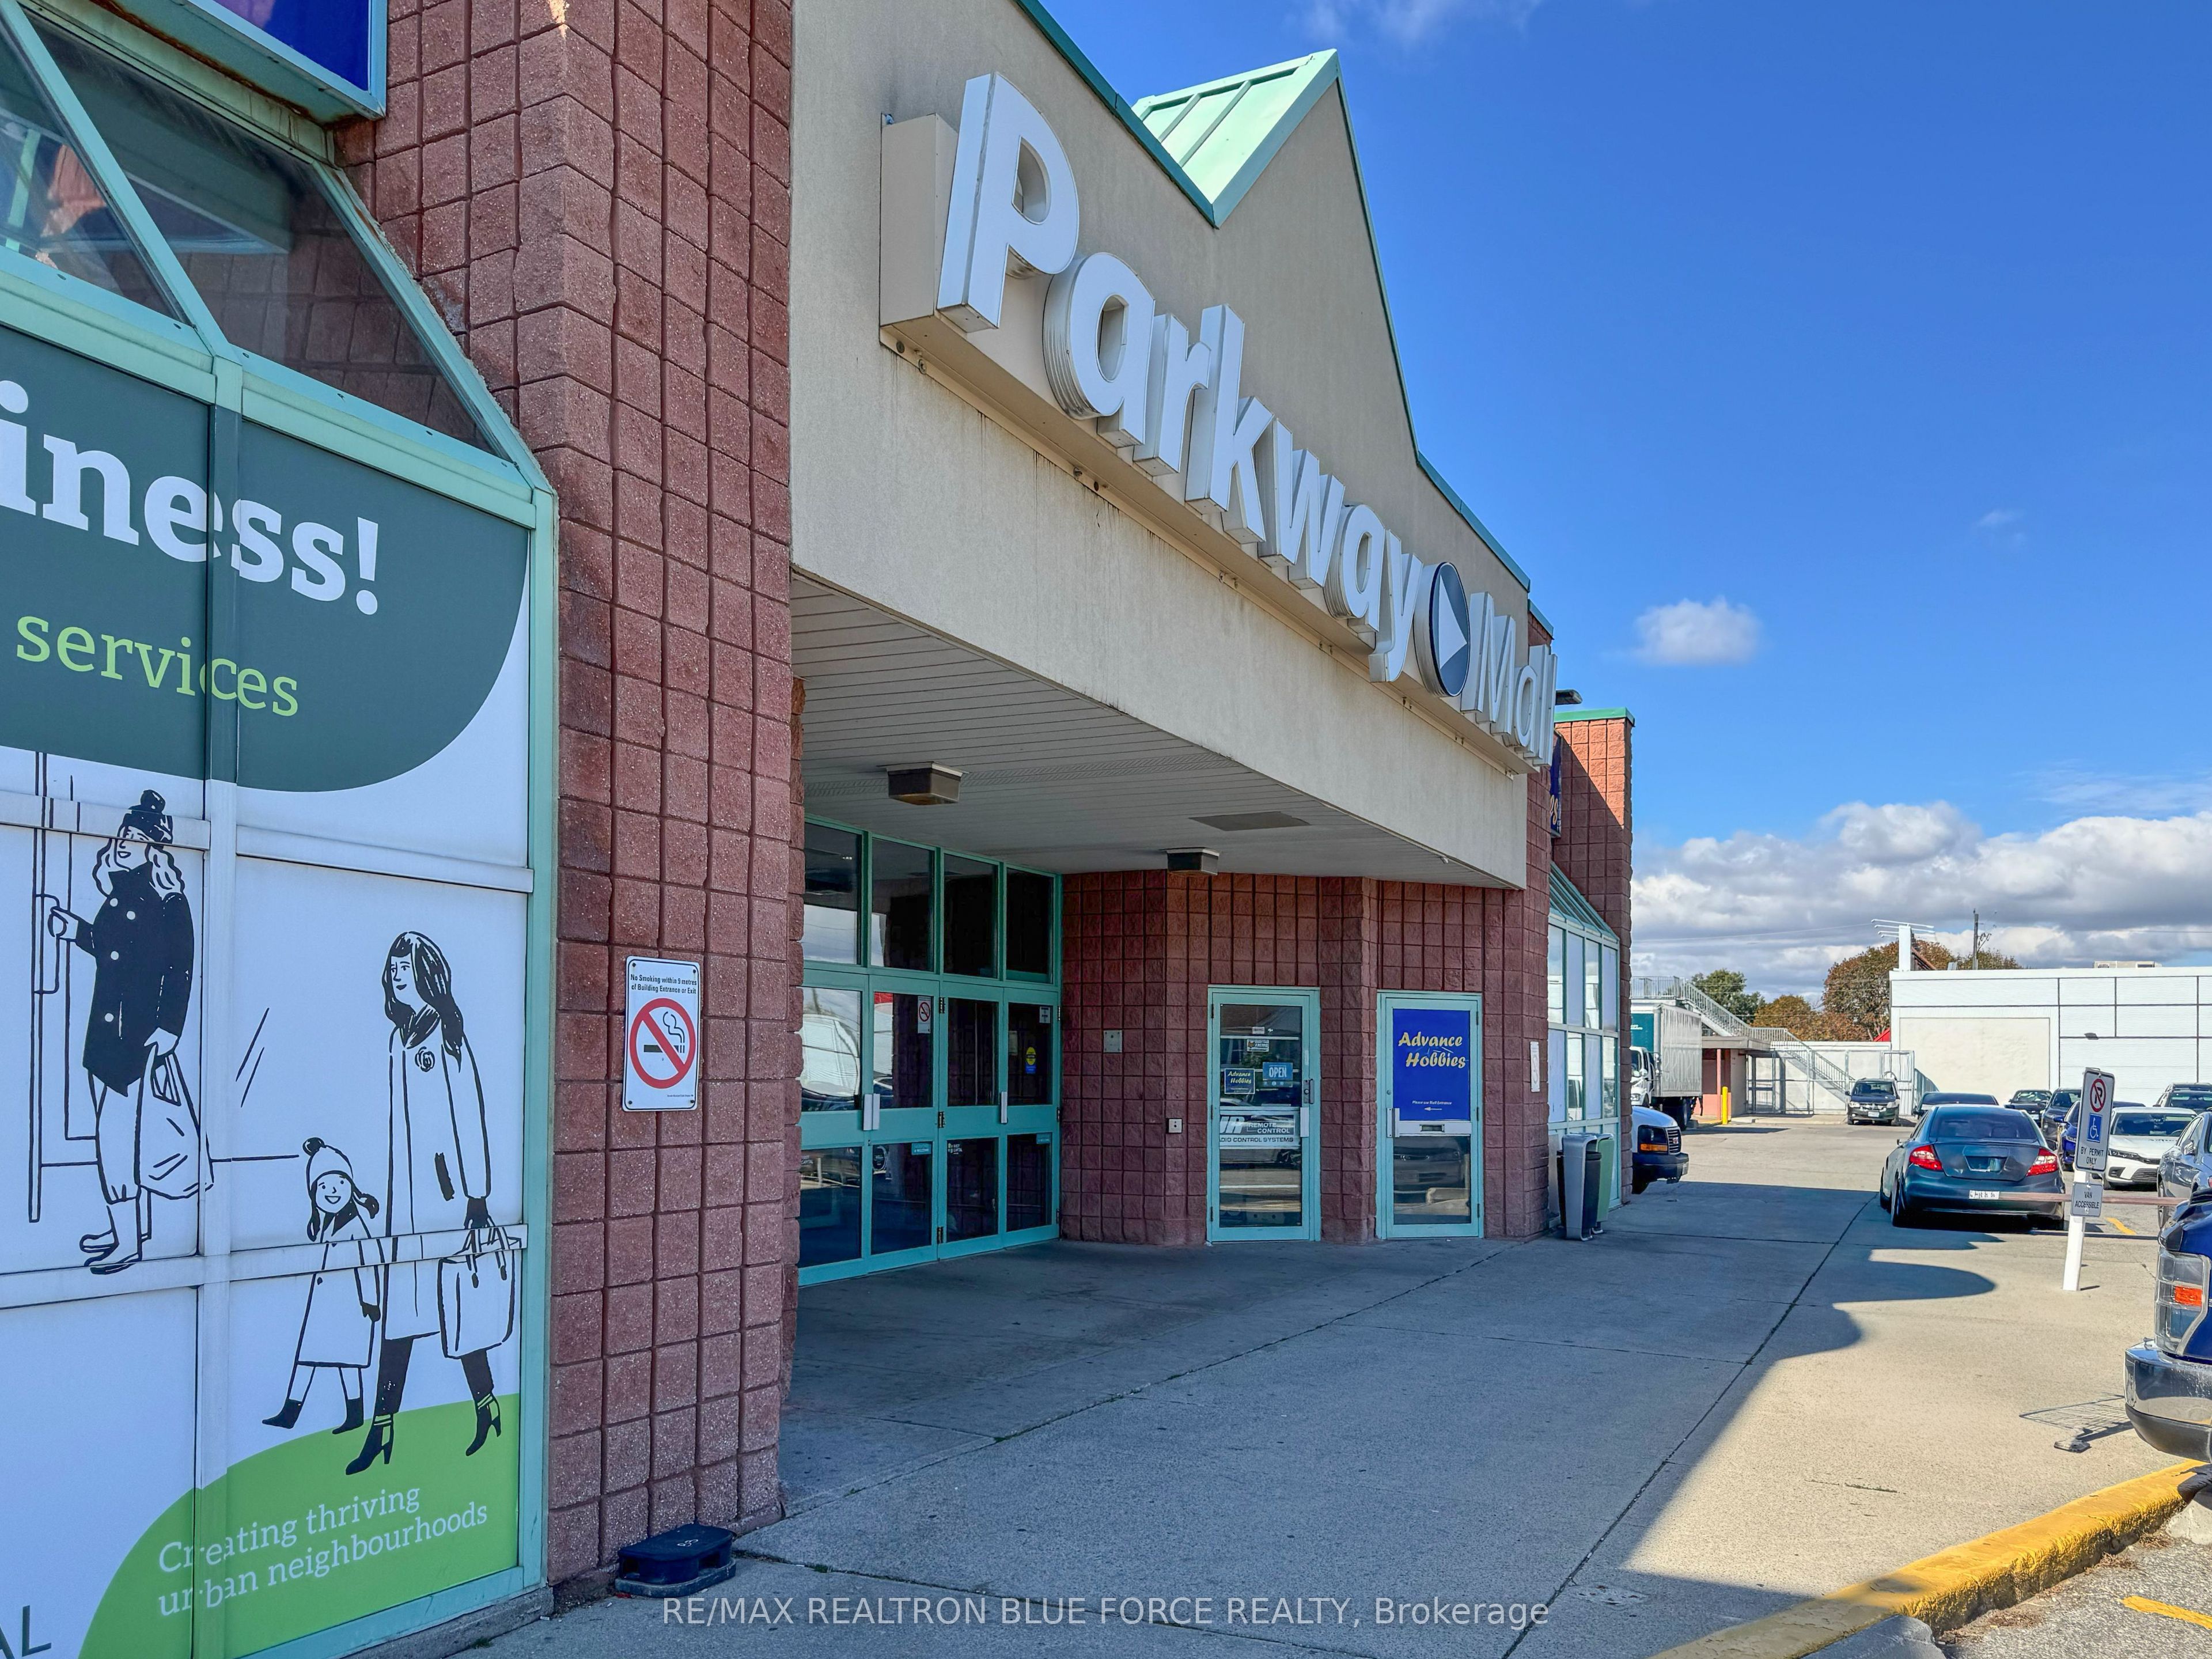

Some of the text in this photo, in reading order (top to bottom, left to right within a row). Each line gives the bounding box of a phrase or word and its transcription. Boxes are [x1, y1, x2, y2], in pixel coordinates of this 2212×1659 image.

[937, 71, 1558, 767] Parkway Mall
[0, 380, 378, 615] iness!
[16, 616, 298, 717] services
[639, 975, 661, 984] Smoking
[637, 984, 658, 993] Building
[1398, 1031, 1463, 1046] Advance
[1406, 1052, 1466, 1069] Hobbies
[1268, 1067, 1287, 1078] OPEN
[2081, 1146, 2104, 1157] BY PERMIT
[2086, 1157, 2097, 1165] ONLY
[2075, 1200, 2100, 1209] ACCESSIBLE
[159, 1488, 420, 1572] Creating thriving
[158, 1501, 487, 1616] urban neighbourhoods
